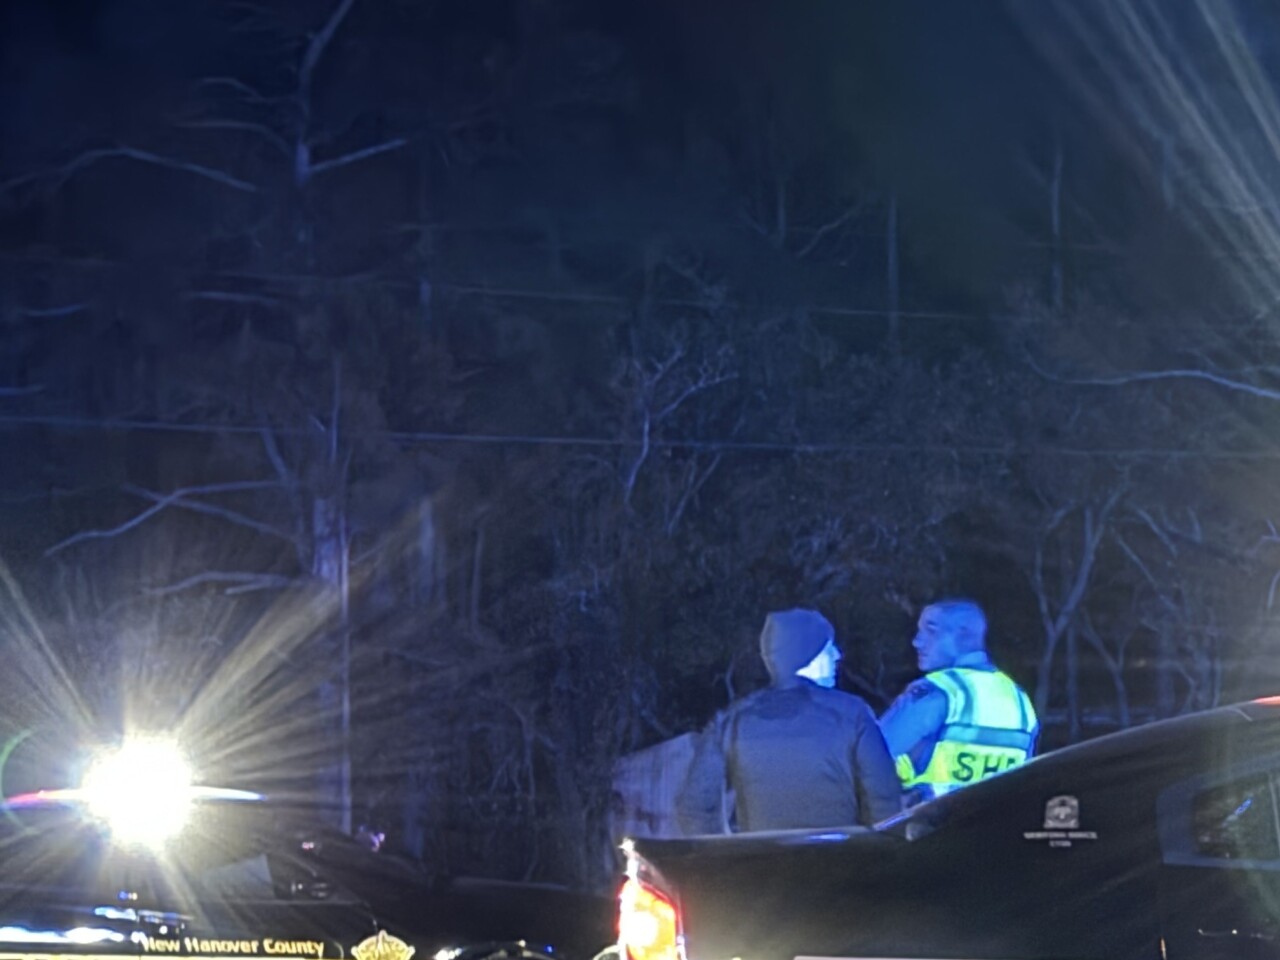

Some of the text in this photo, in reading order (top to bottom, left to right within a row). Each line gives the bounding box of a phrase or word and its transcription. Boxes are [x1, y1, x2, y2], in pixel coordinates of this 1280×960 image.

[141, 936, 325, 959] New Hanover County
